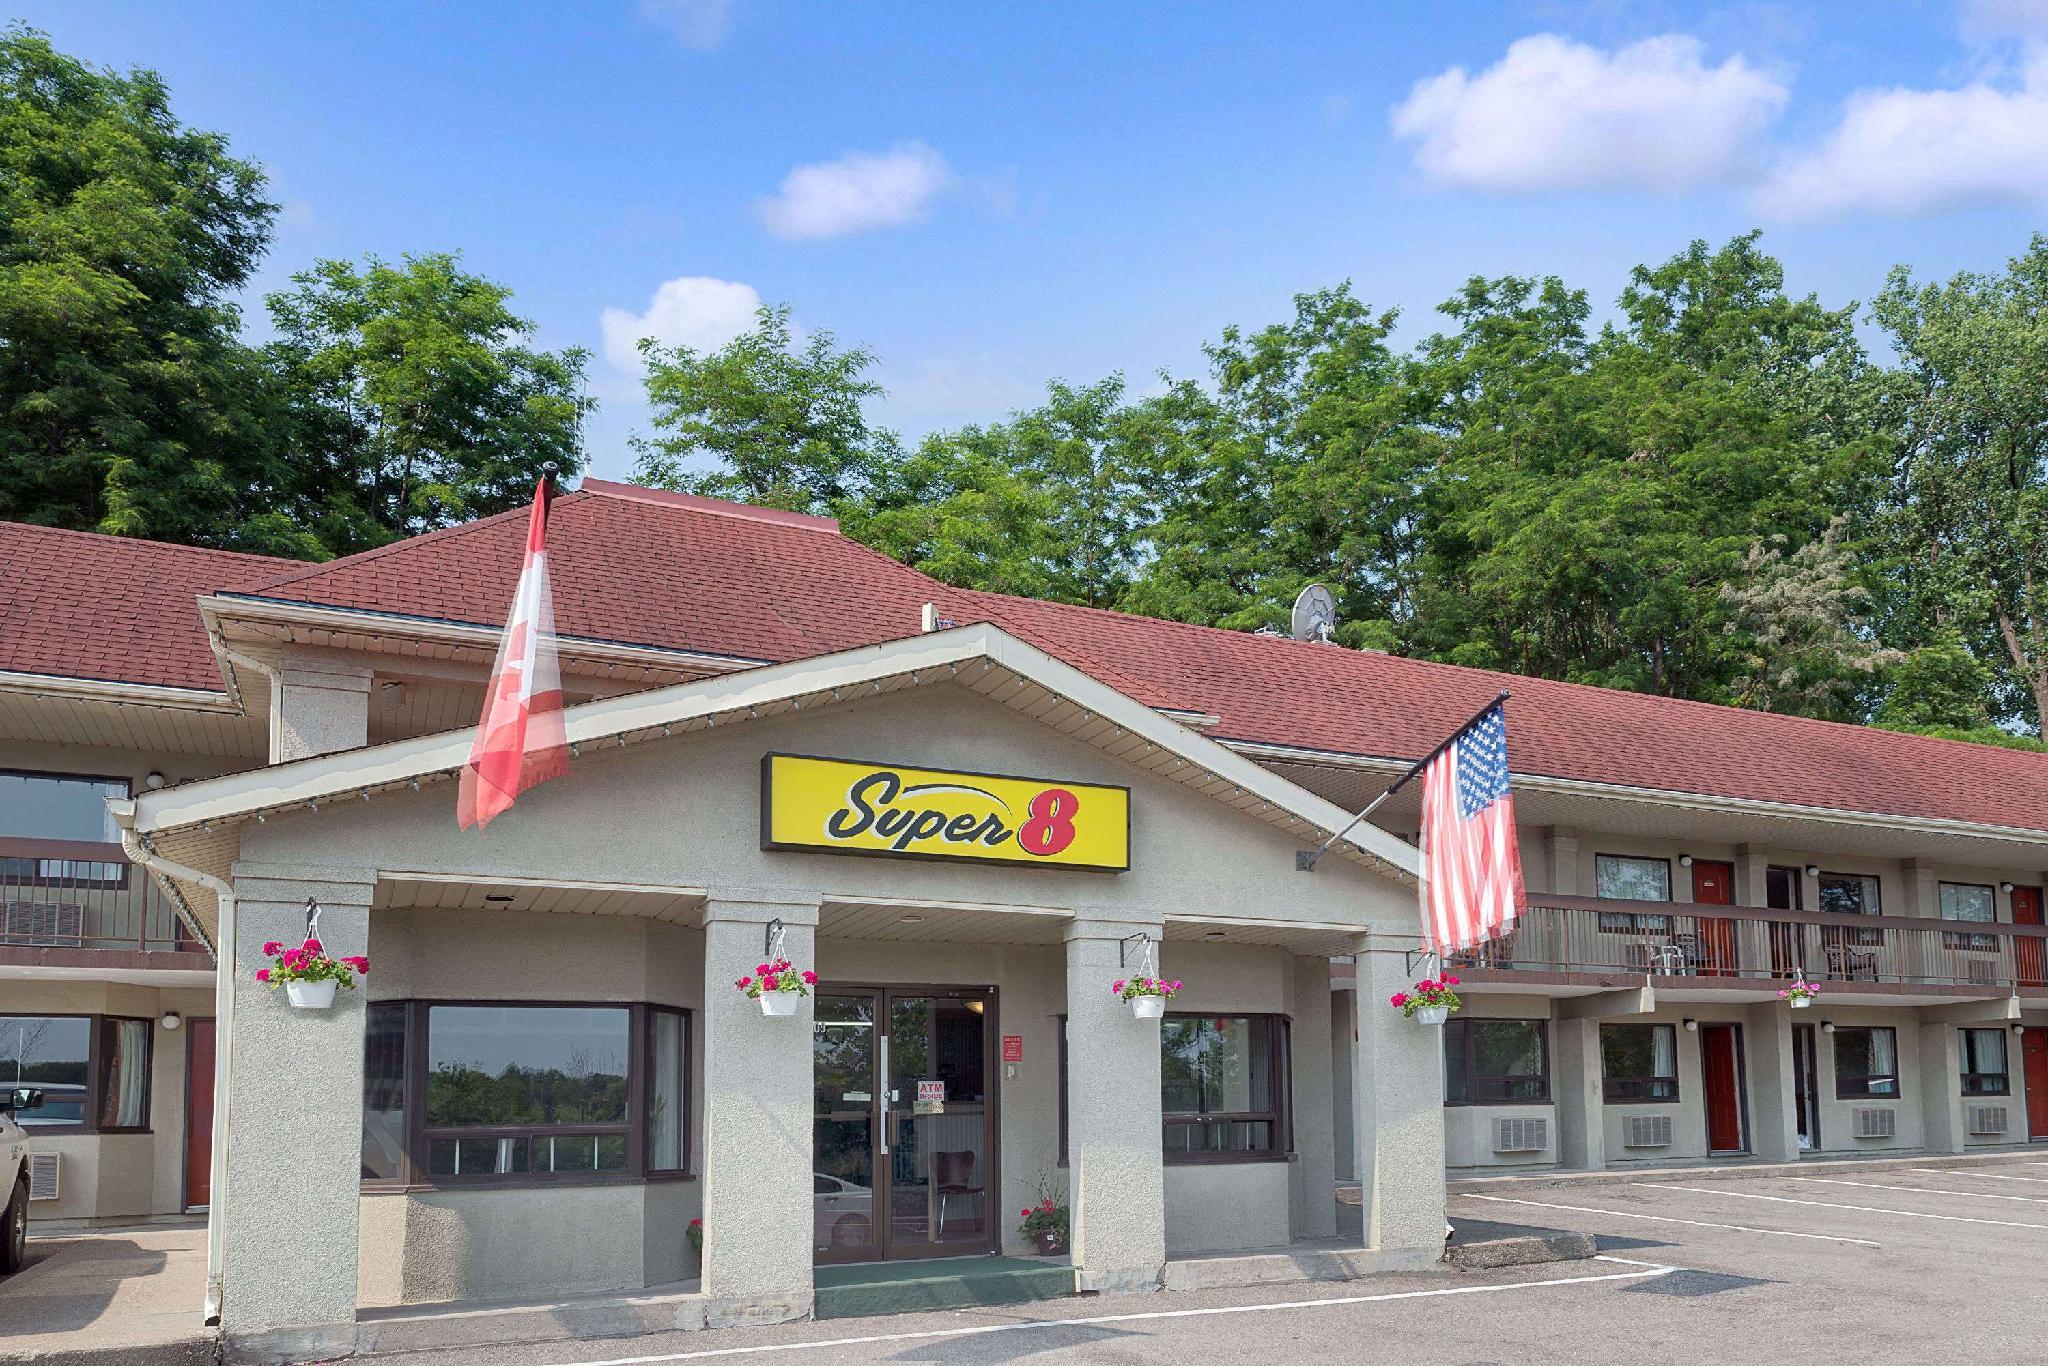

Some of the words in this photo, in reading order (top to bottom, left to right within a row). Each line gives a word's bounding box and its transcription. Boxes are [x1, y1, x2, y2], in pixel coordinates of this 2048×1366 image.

[824, 771, 1014, 851] Super
[1017, 788, 1080, 856] 8
[920, 1083, 942, 1092] ATM
